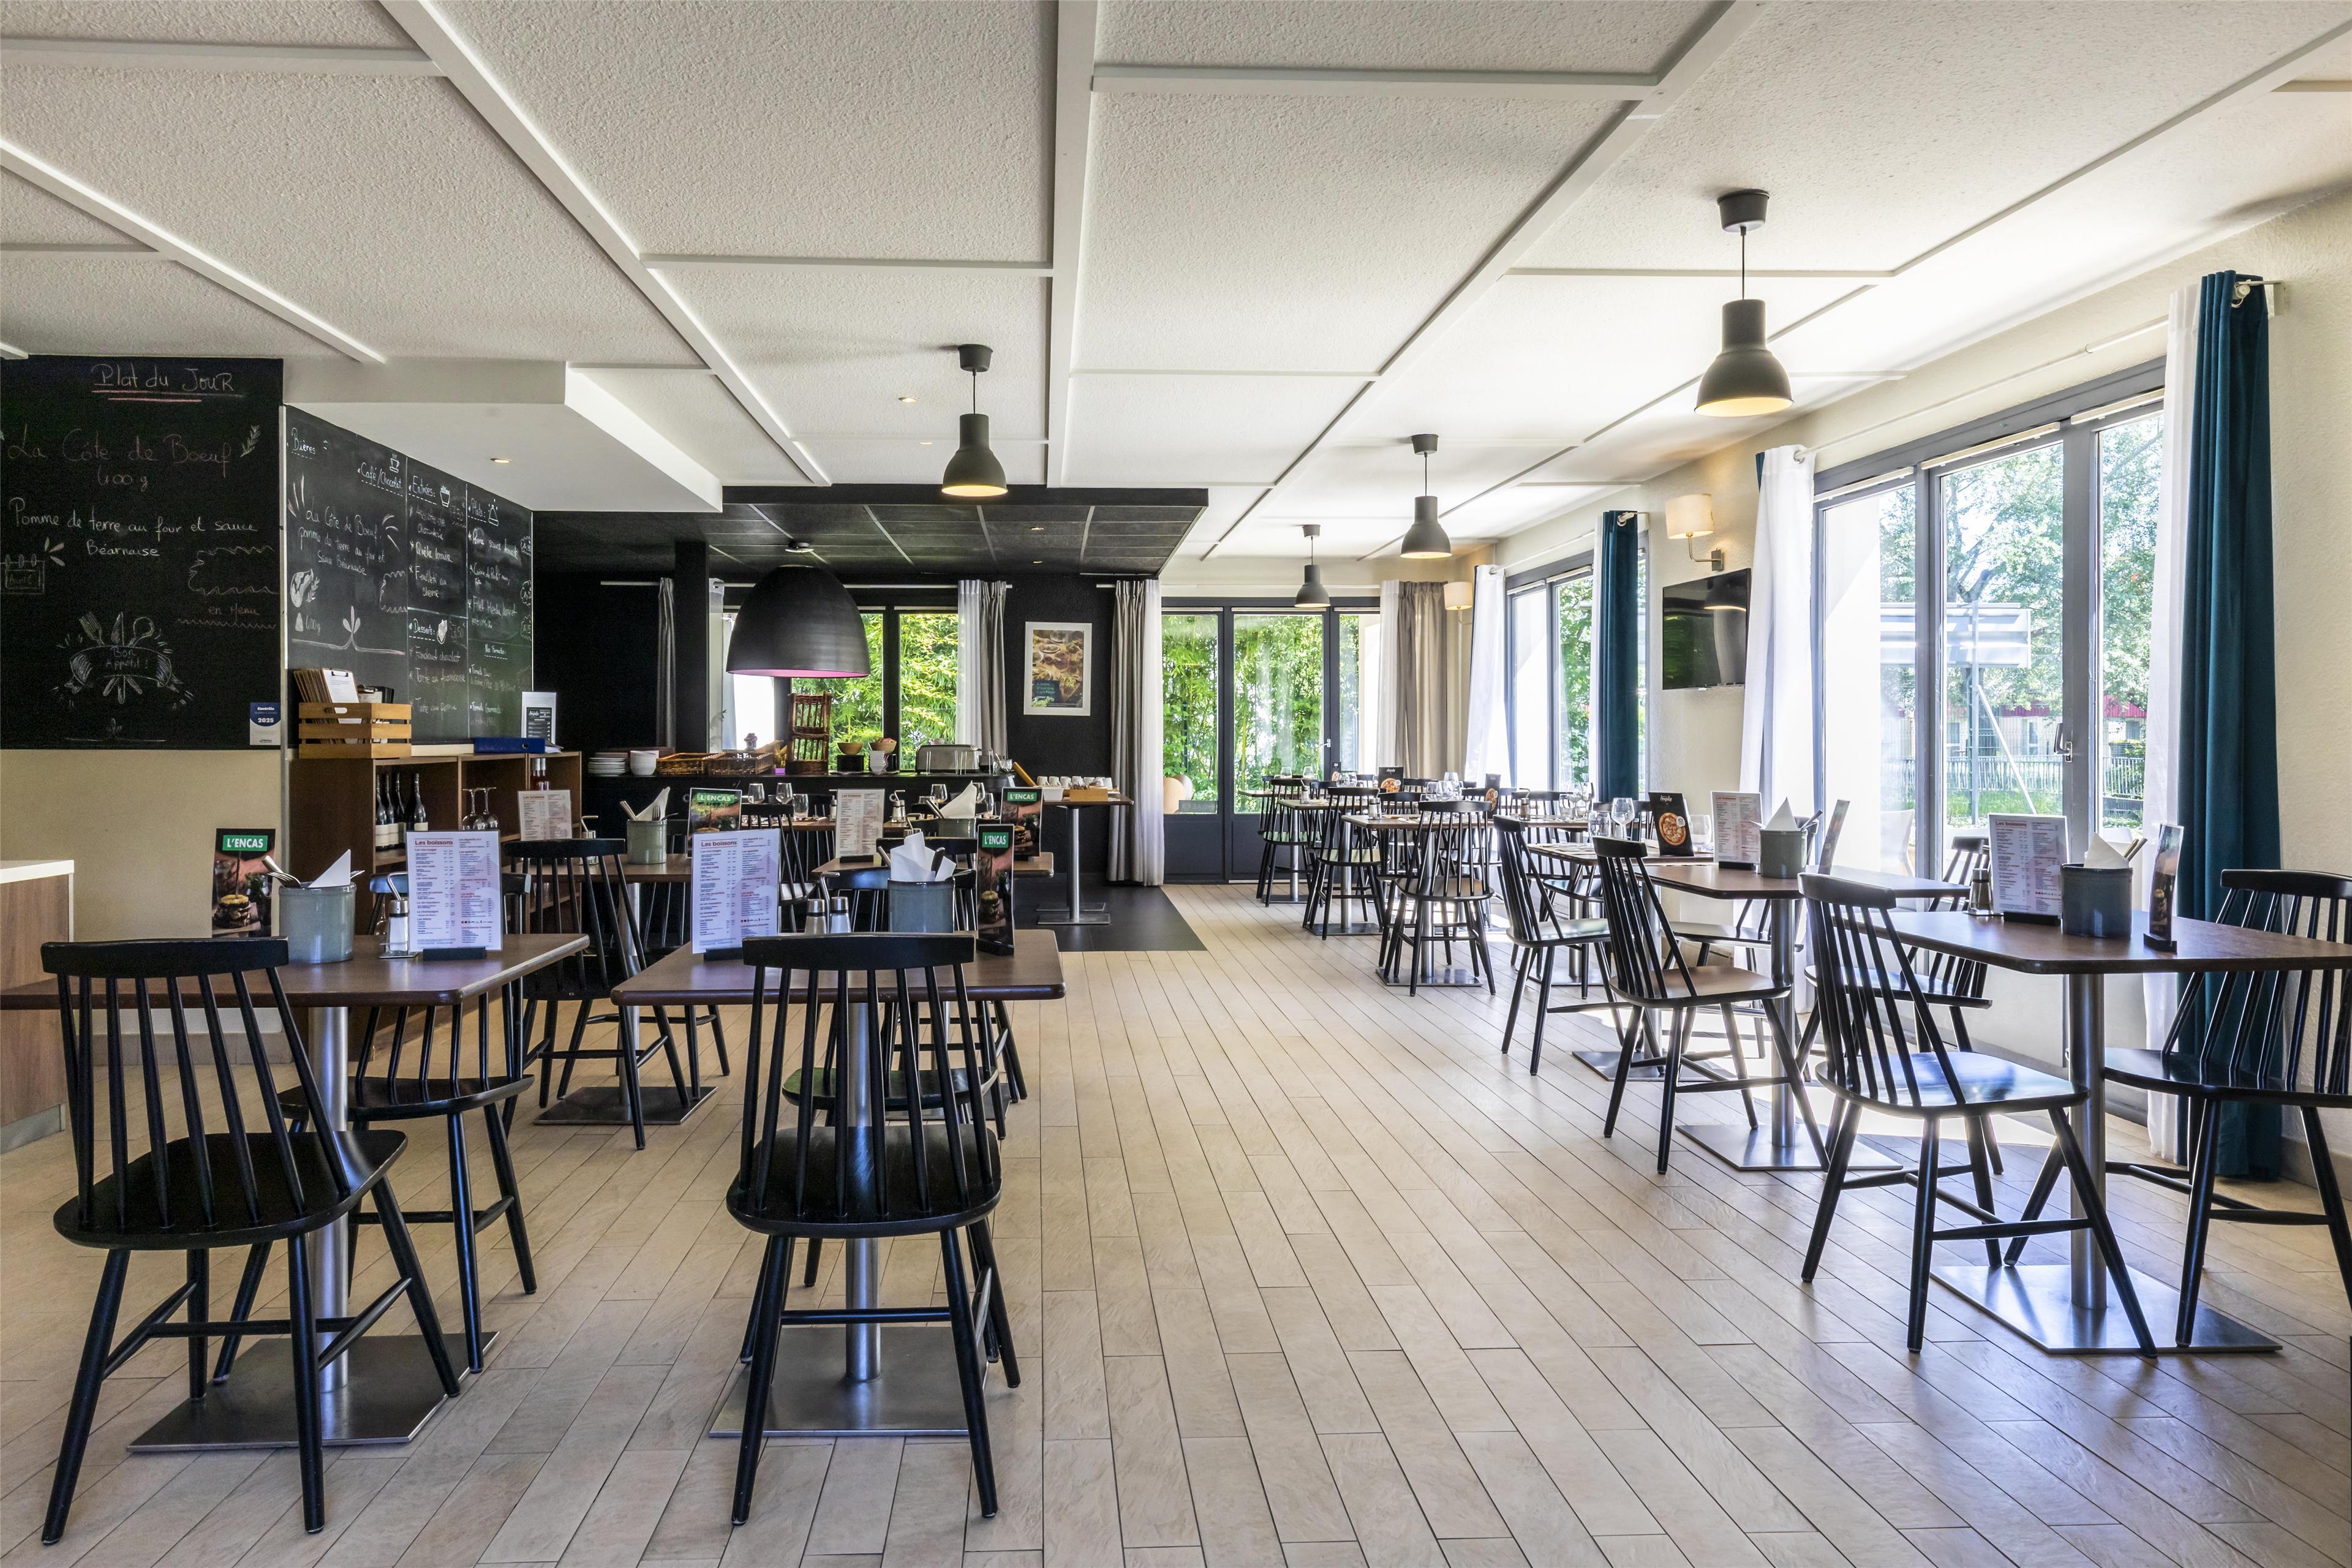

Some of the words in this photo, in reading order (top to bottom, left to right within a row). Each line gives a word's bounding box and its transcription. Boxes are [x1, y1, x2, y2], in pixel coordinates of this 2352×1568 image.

[91, 363, 138, 387] Plat
[146, 366, 168, 387] du
[128, 435, 156, 460] de
[9, 497, 59, 527] Pomme
[67, 510, 81, 528] de
[89, 506, 120, 532] terre
[156, 516, 182, 541] four
[190, 516, 205, 532] et
[227, 838, 263, 848] L'ENCAS
[984, 835, 1006, 845] L'ENCAS
